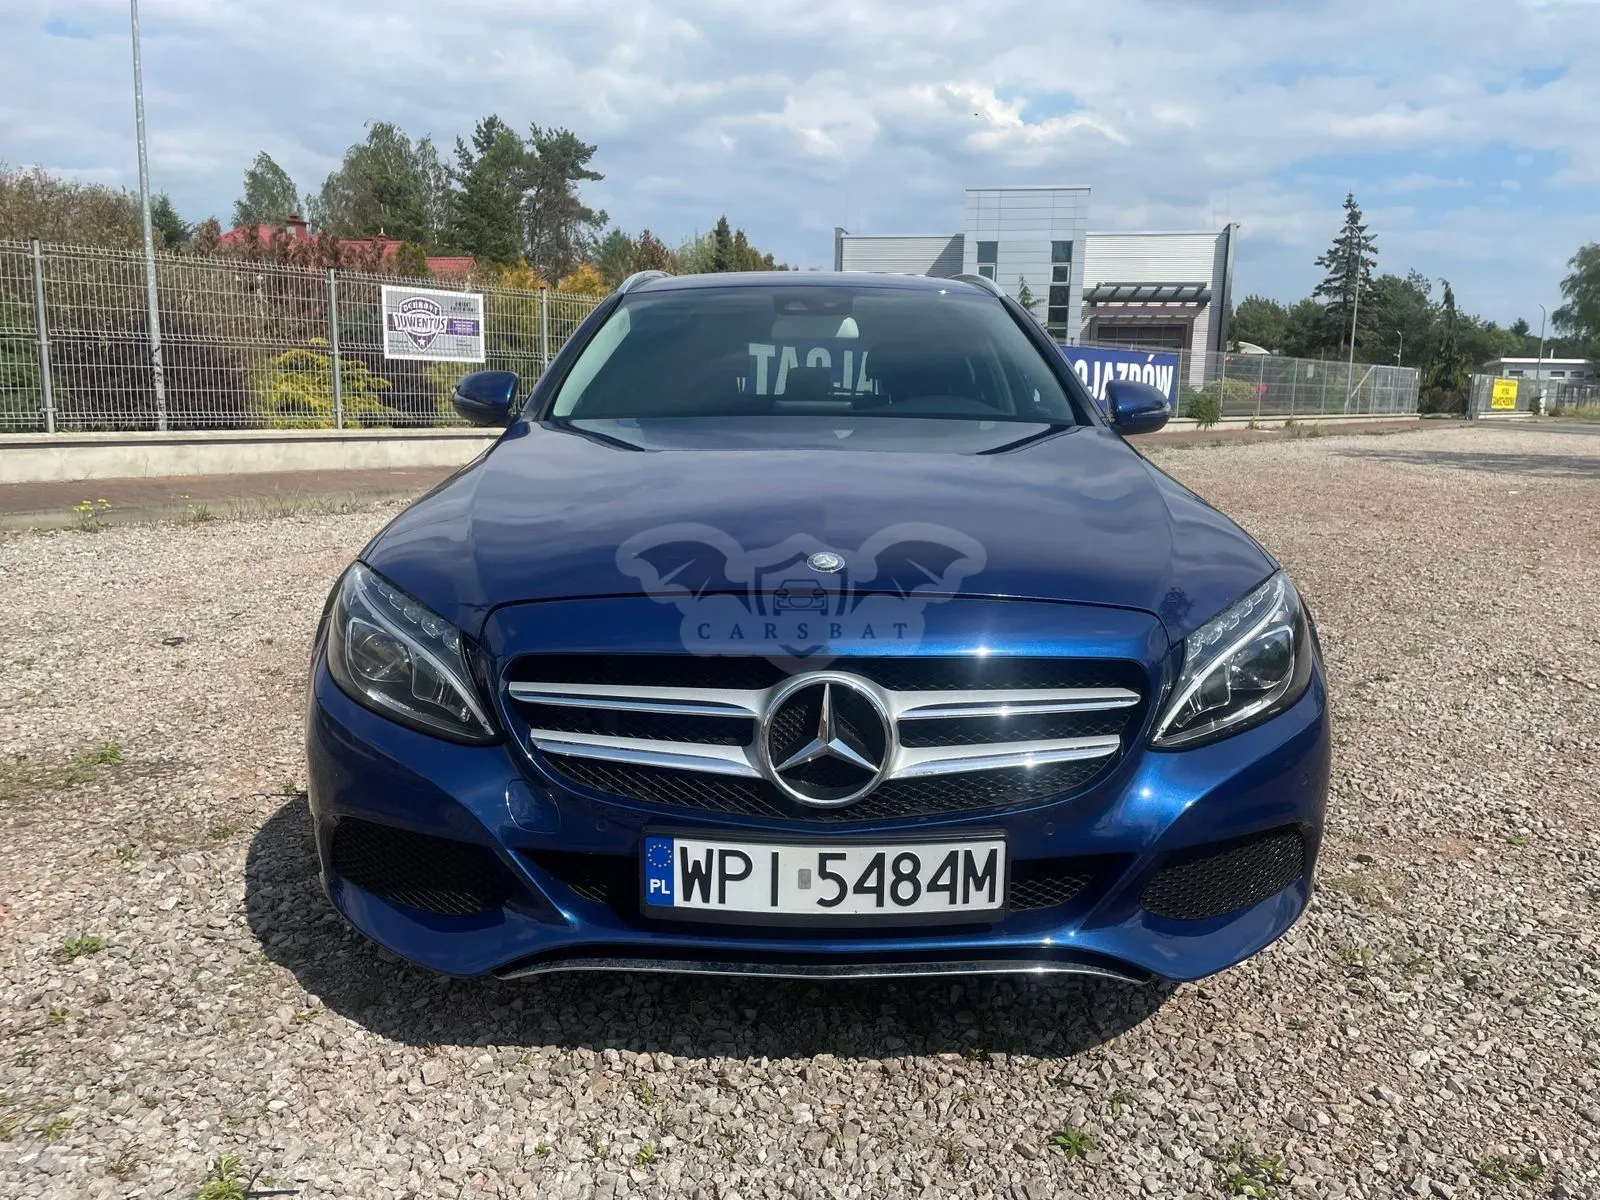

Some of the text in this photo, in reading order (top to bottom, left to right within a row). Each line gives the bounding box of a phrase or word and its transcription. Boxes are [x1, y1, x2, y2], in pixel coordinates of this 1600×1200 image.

[395, 314, 446, 331] JUWENTUS
[679, 846, 998, 908] WPI 5484M
[650, 878, 671, 895] PL
